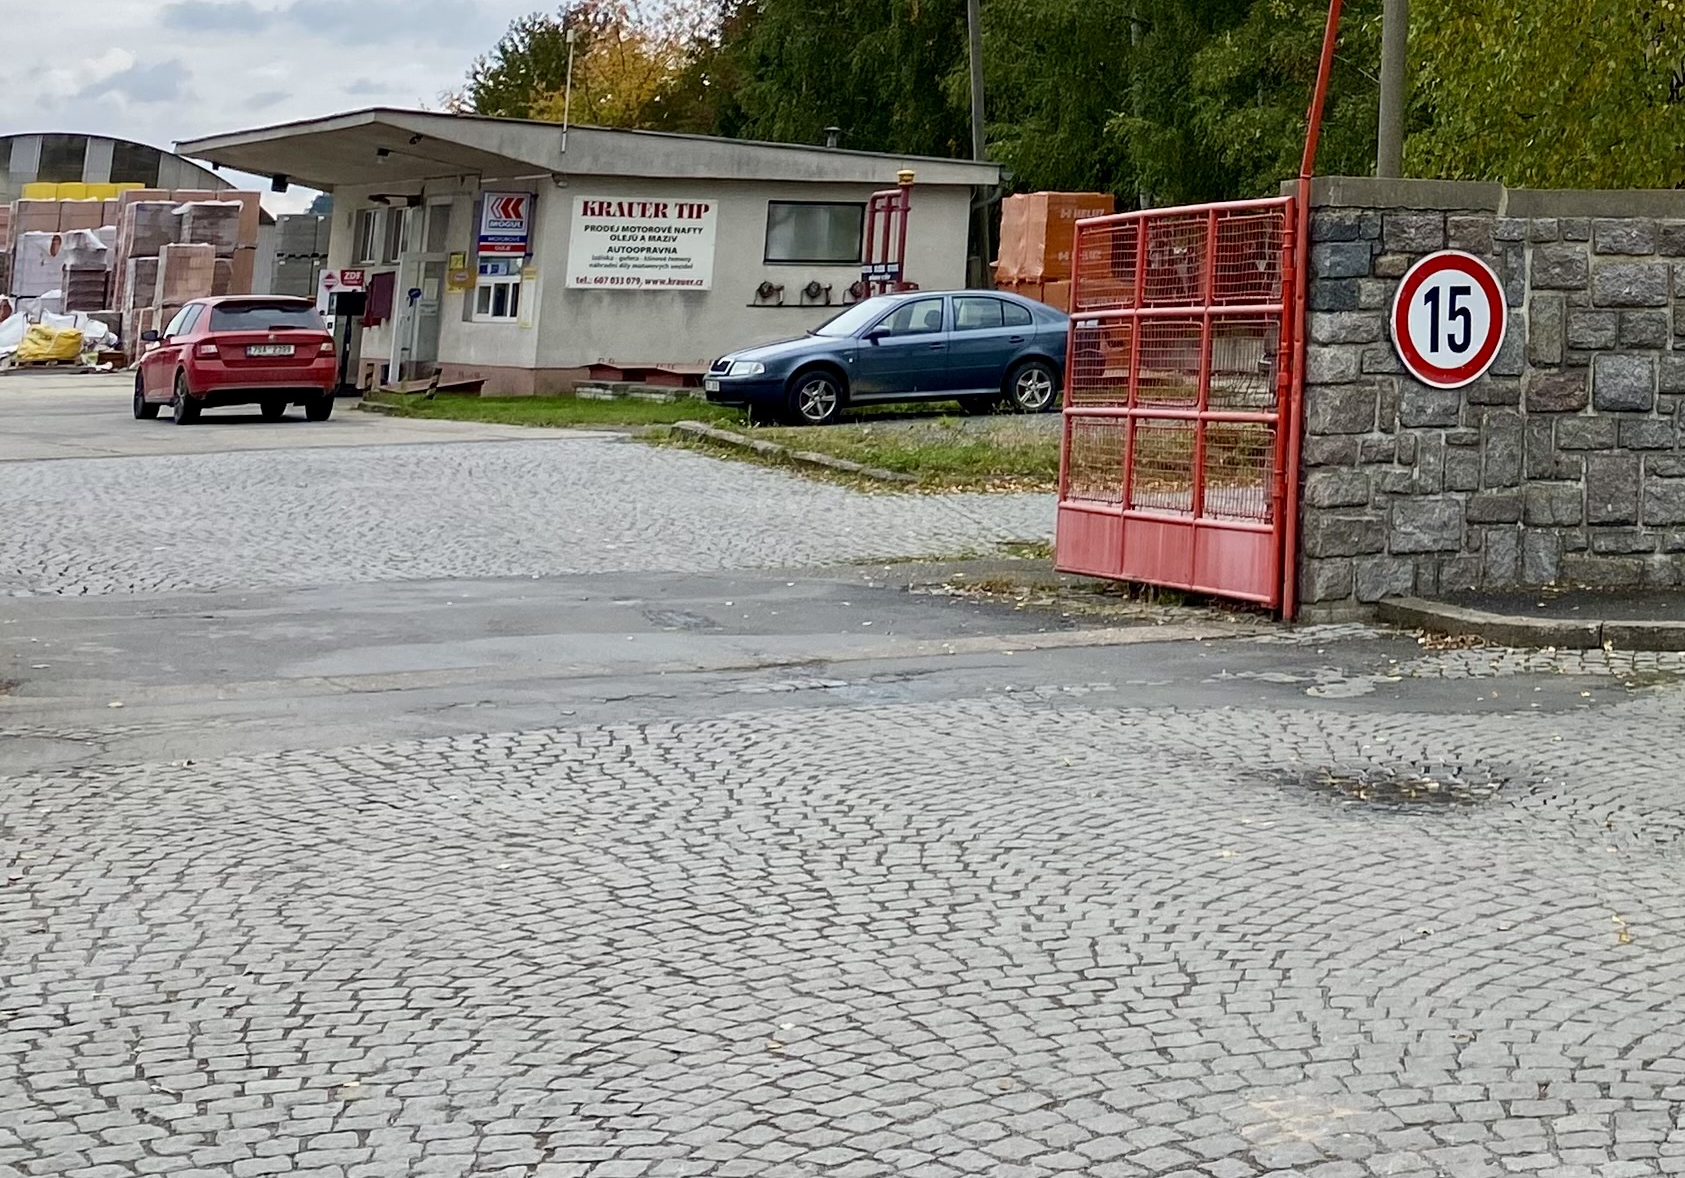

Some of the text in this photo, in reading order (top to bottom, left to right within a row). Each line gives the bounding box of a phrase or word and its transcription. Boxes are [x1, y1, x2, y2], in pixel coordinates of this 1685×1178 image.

[581, 200, 710, 219] KRAUER TIP
[584, 224, 704, 235] PRODEJ MOTOROVÉ NAFTY
[648, 235, 678, 243] MAZIV
[606, 246, 678, 254] AUTOOPRAVNA
[593, 276, 609, 285] 607
[610, 277, 625, 285] 033
[644, 277, 703, 286] www.krauer.cz
[1424, 285, 1472, 354] 15
